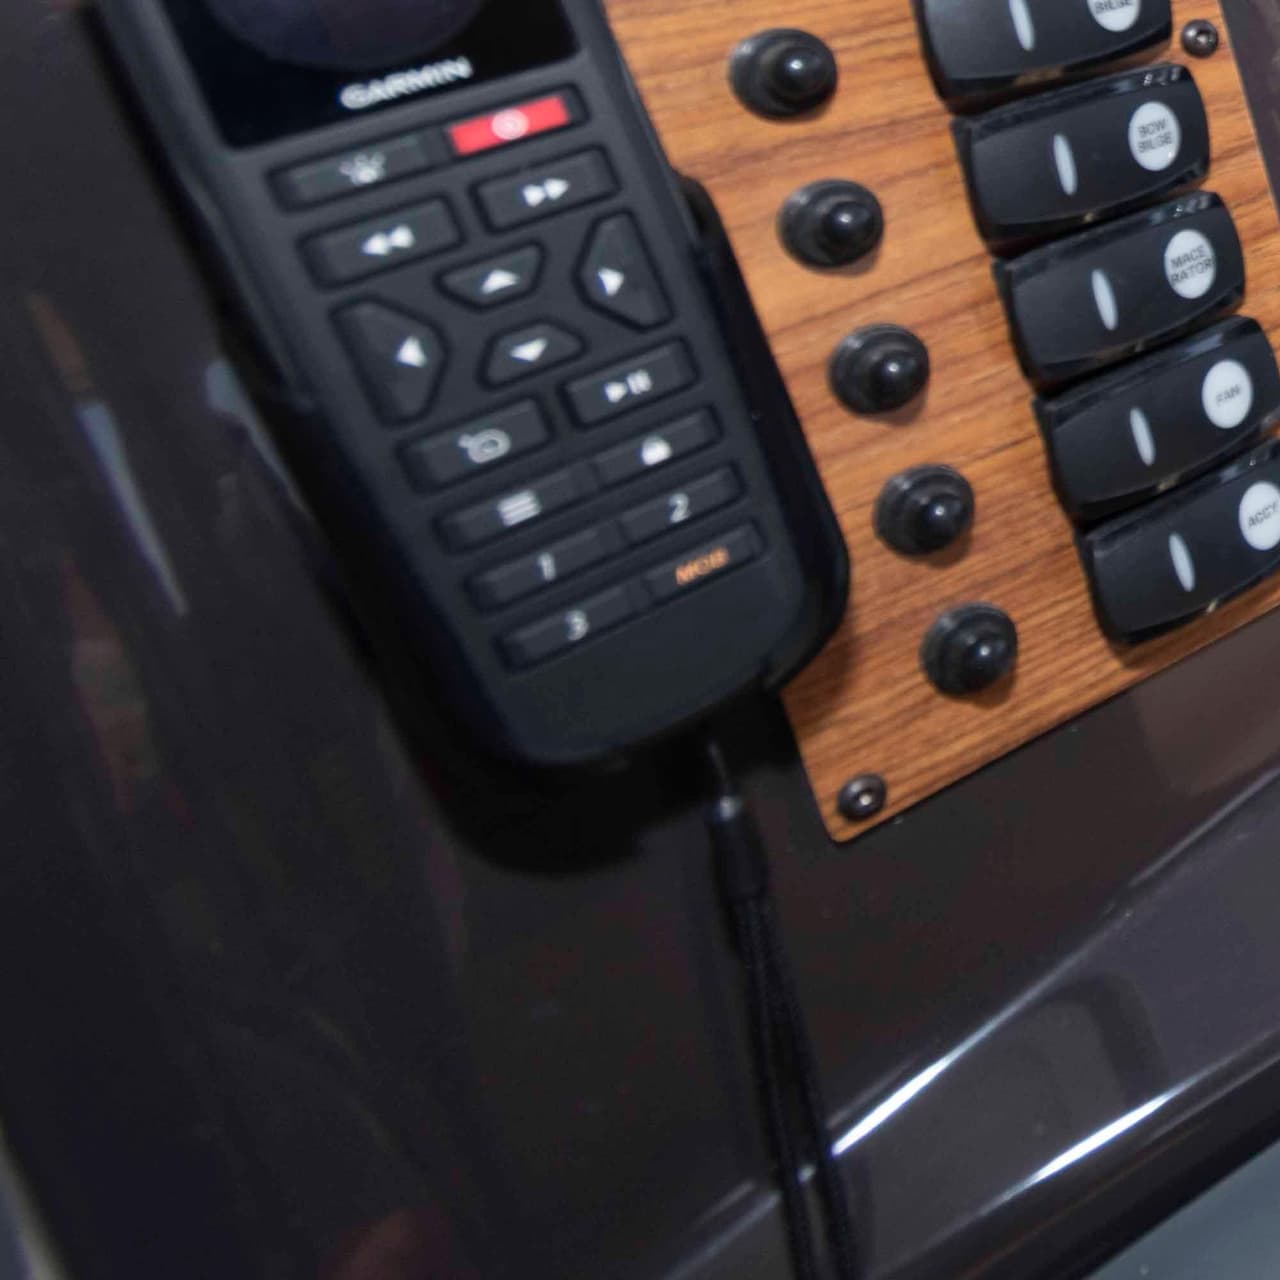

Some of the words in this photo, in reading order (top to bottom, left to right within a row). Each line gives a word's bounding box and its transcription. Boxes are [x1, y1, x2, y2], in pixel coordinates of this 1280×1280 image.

[340, 56, 474, 110] GARMIN
[1215, 384, 1241, 407] FAN
[668, 492, 690, 523] 2
[1248, 502, 1279, 528] ACCY
[537, 552, 557, 581] 1
[675, 546, 730, 586] MOB
[565, 610, 589, 641] 3
